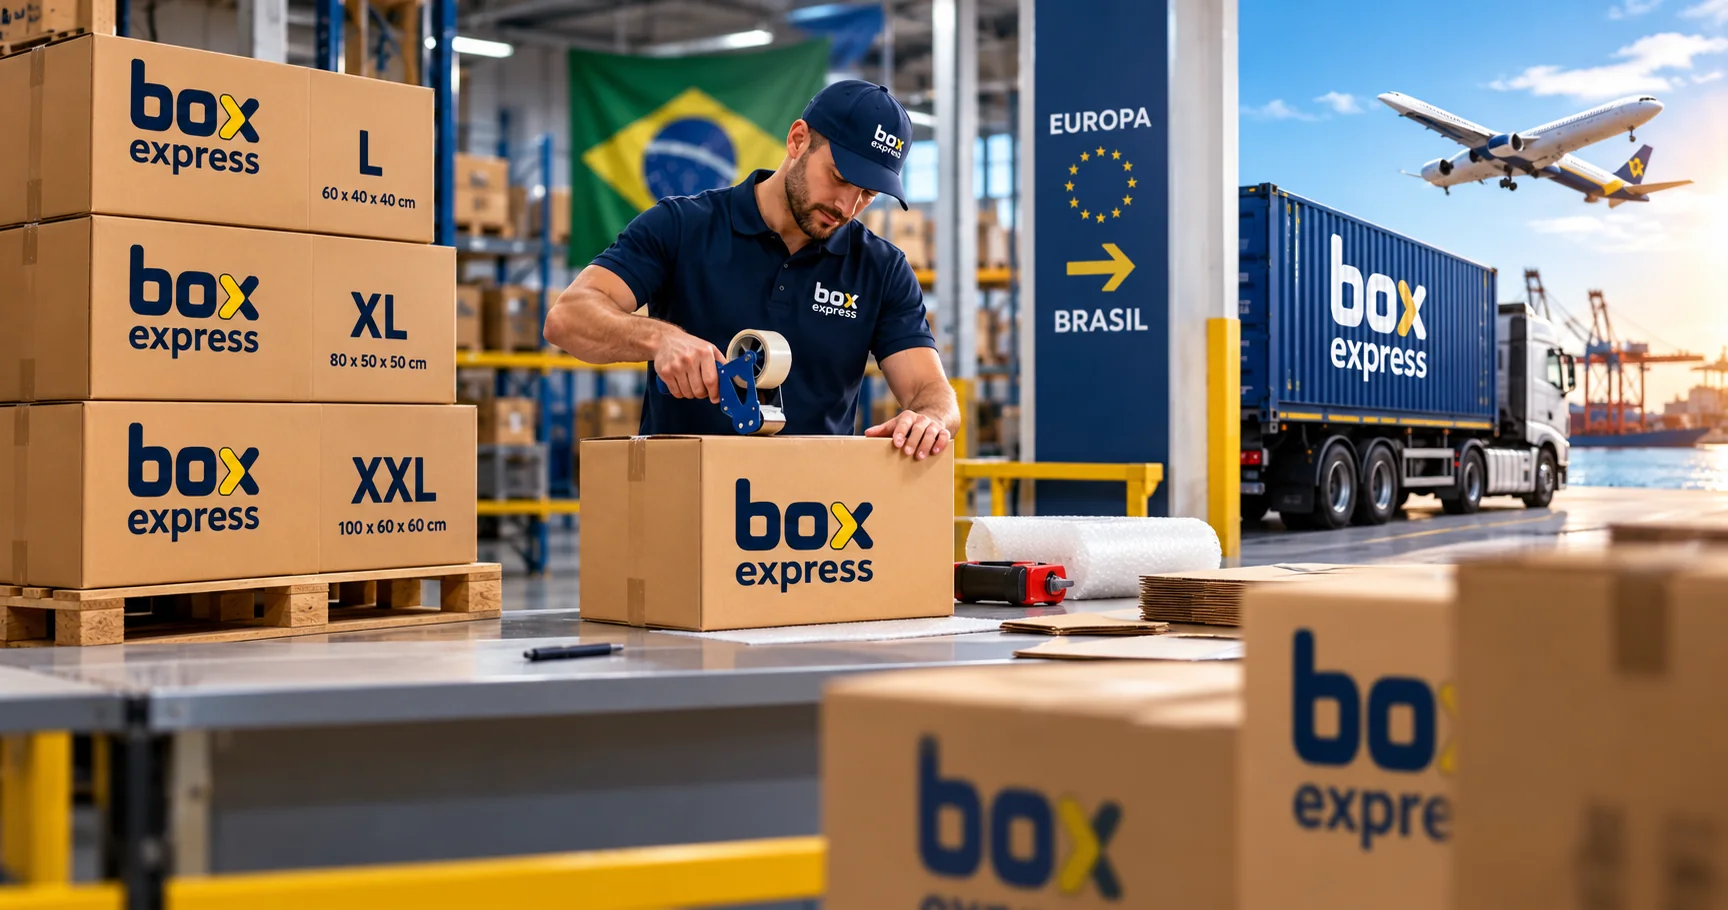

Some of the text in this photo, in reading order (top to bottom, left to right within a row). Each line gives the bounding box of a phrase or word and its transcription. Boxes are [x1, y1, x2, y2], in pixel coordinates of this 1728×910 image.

[130, 58, 260, 144] box
[874, 123, 905, 152] box
[1050, 107, 1151, 135] EUROPA
[129, 139, 260, 176] express
[360, 129, 383, 177] L
[321, 186, 416, 209] 60 x 40 x 40 cm
[129, 244, 260, 321] box
[814, 281, 860, 310] box
[1330, 233, 1427, 341] box
[350, 291, 408, 340] XL
[811, 303, 857, 319] express
[1055, 308, 1149, 333] BRASIL
[128, 325, 260, 360] express
[329, 353, 427, 370] 80 x 50 x 50 cm
[1330, 337, 1428, 383] express
[127, 422, 260, 498] box
[351, 456, 437, 505] XXL
[127, 505, 260, 543] express
[338, 518, 447, 536] 100 x 60 x 60 cm
[735, 478, 874, 551] box
[735, 559, 874, 593] express
[1292, 627, 1457, 776] bo
[916, 734, 1125, 902] box
